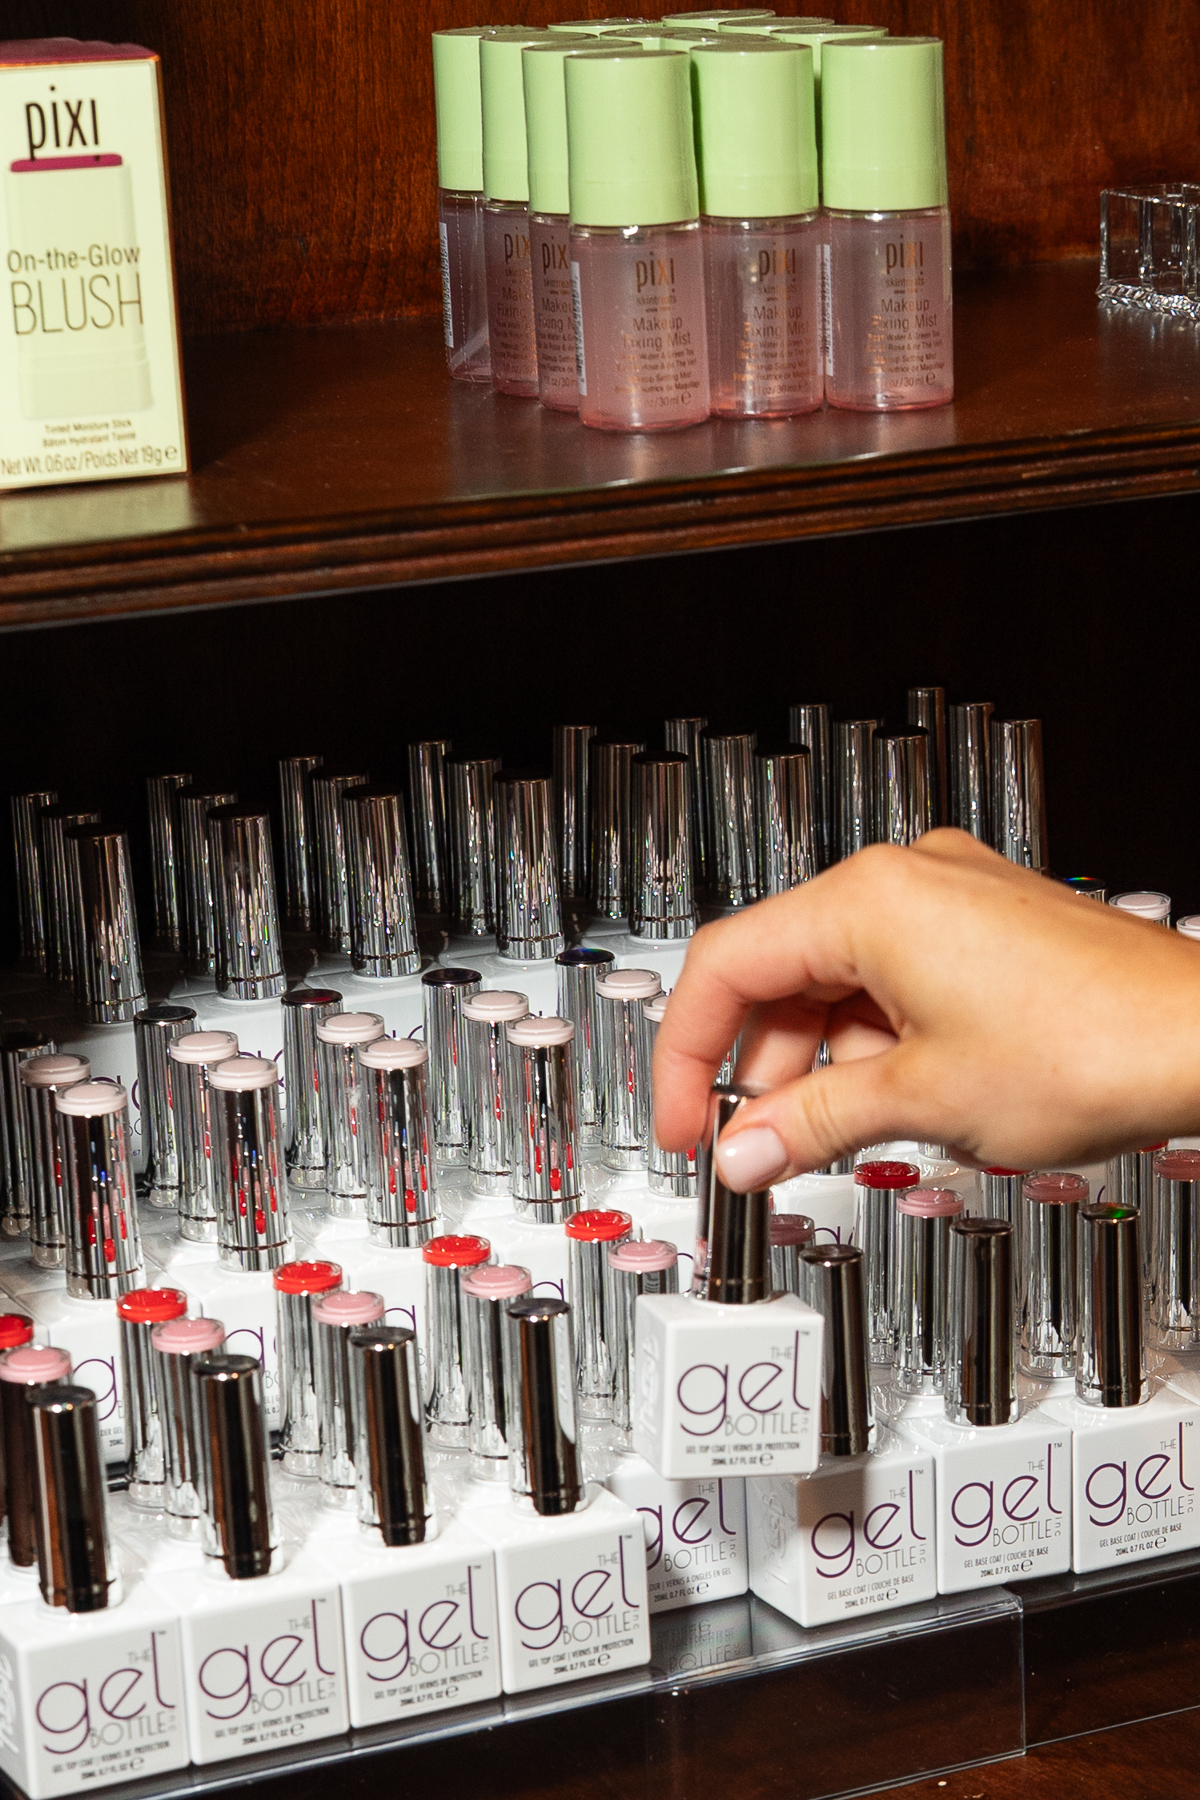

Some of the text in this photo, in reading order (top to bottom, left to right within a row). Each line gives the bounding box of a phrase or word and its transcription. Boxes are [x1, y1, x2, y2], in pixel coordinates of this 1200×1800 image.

[25, 85, 99, 162] pixi
[7, 244, 141, 273] On-the-Glow
[759, 242, 796, 282] pixi
[886, 234, 924, 275] pixi
[636, 251, 675, 293] pixi
[11, 272, 143, 335] BLUSH
[881, 299, 929, 313] Makeup
[633, 317, 682, 331] Makeup
[915, 314, 937, 328] Mist
[668, 332, 691, 346] Mist
[1, 449, 138, 475] Net Net
[771, 1346, 792, 1360] THE
[677, 1330, 810, 1436] gel
[725, 1412, 799, 1436] BOTTLE
[1160, 1438, 1176, 1451] THE
[1028, 1460, 1045, 1471] THE
[1086, 1422, 1194, 1527] gel
[698, 1482, 715, 1495] THE
[889, 1487, 906, 1499] THE
[951, 1443, 1062, 1547] gel
[811, 1470, 926, 1578] gel
[1127, 1496, 1184, 1526] BOTTLE
[993, 1518, 1052, 1547] BOTTLE
[1100, 1523, 1182, 1548] GEL BASE COAT COUCHE DE BASE
[598, 1552, 618, 1566] THE
[664, 1541, 726, 1572] BOTTLE
[856, 1546, 916, 1577] BOTTLE
[964, 1560, 973, 1568] GEL
[975, 1557, 987, 1566] BASE
[989, 1555, 1002, 1564] COAT
[1007, 1550, 1027, 1560] COUCHE
[1037, 1547, 1048, 1555] BASE
[1116, 1547, 1128, 1556] 20ML
[1146, 1541, 1153, 1549] OZ
[827, 1574, 914, 1600] GEL BASE COAT COUCHE DE BASE
[981, 1569, 994, 1577] 20ML
[446, 1582, 467, 1597] THE
[515, 1536, 639, 1650] gel
[845, 1597, 868, 1609] 20ML 0.7
[289, 1615, 311, 1631] THE
[361, 1566, 488, 1681] gel
[563, 1611, 631, 1645] BOTTLE
[199, 1599, 335, 1719] gel
[409, 1642, 479, 1676] BOTTLE
[36, 1632, 175, 1754] gel
[251, 1677, 326, 1714] BOTTLE
